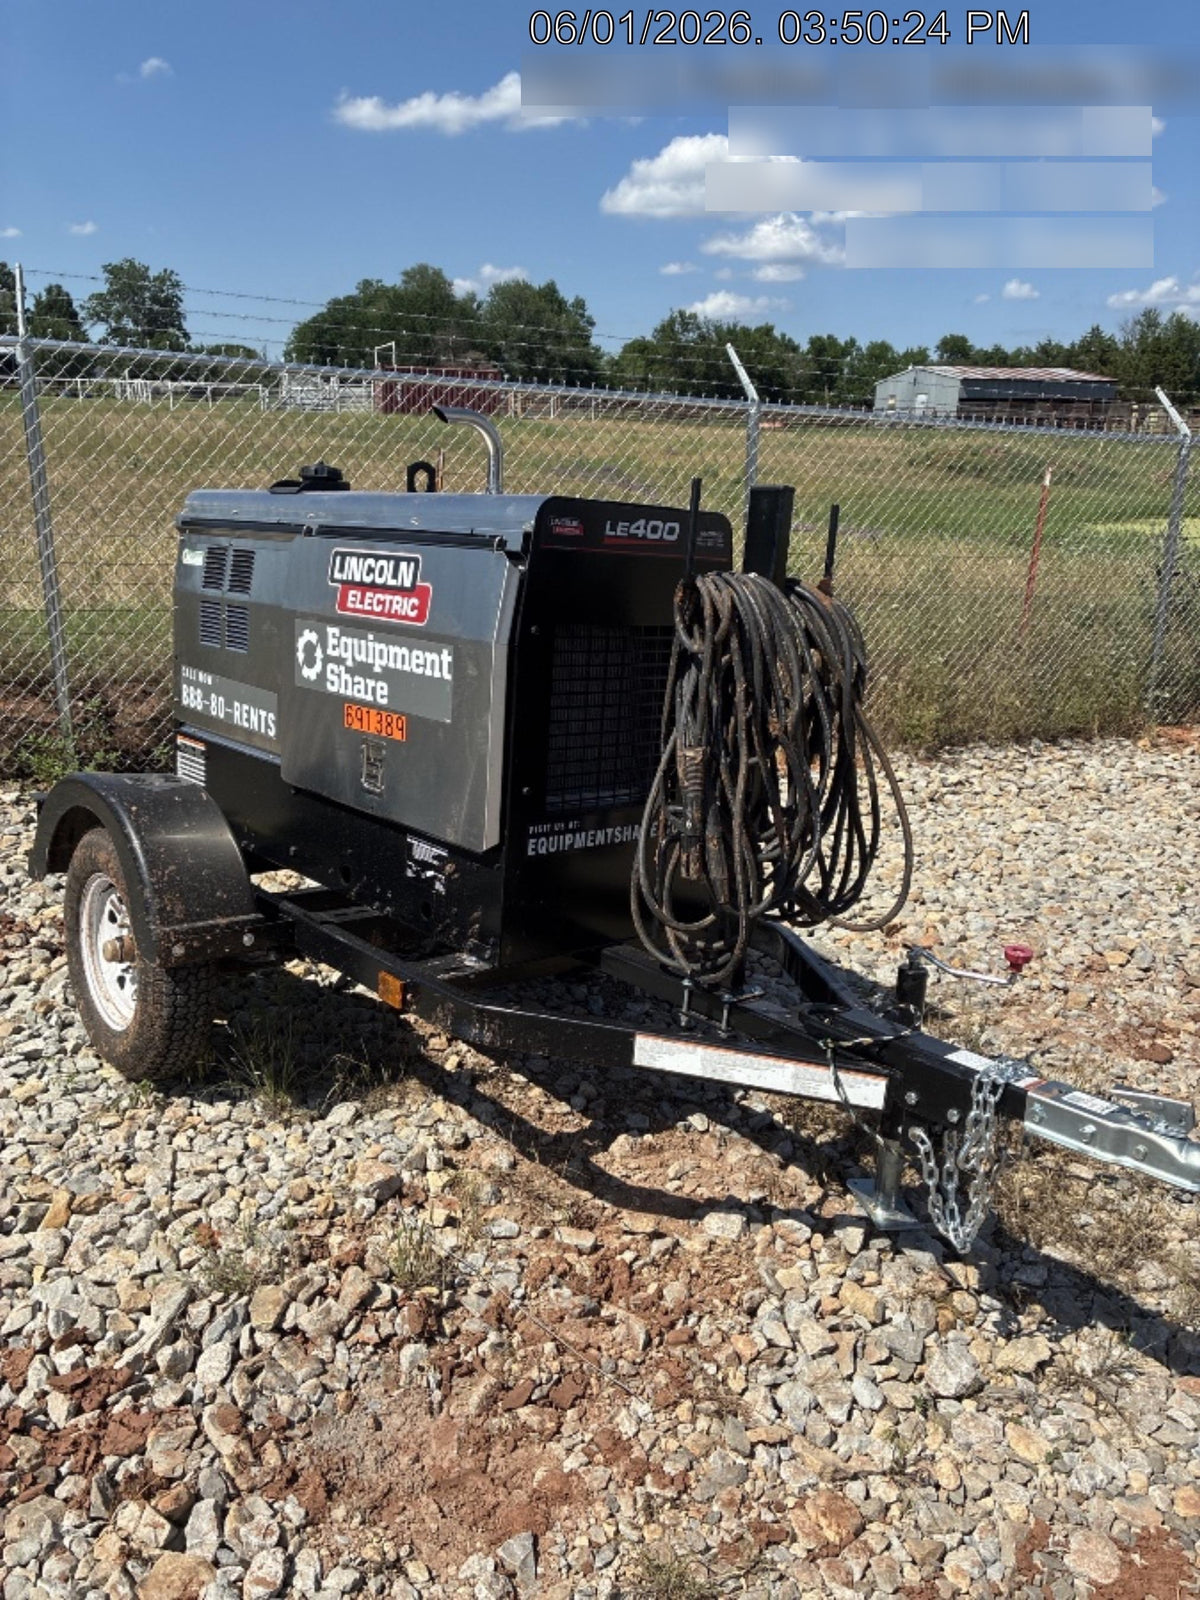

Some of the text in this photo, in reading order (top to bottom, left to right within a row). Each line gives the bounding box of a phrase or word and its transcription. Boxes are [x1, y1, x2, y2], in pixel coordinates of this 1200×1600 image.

[604, 519, 679, 541] LE400
[332, 555, 415, 589] LINCOLN
[346, 592, 420, 619] ELECTRIC
[326, 625, 453, 681] Equipment
[326, 664, 389, 705] Share
[181, 683, 277, 738] 888-80-RENTS
[345, 704, 406, 740] 691389
